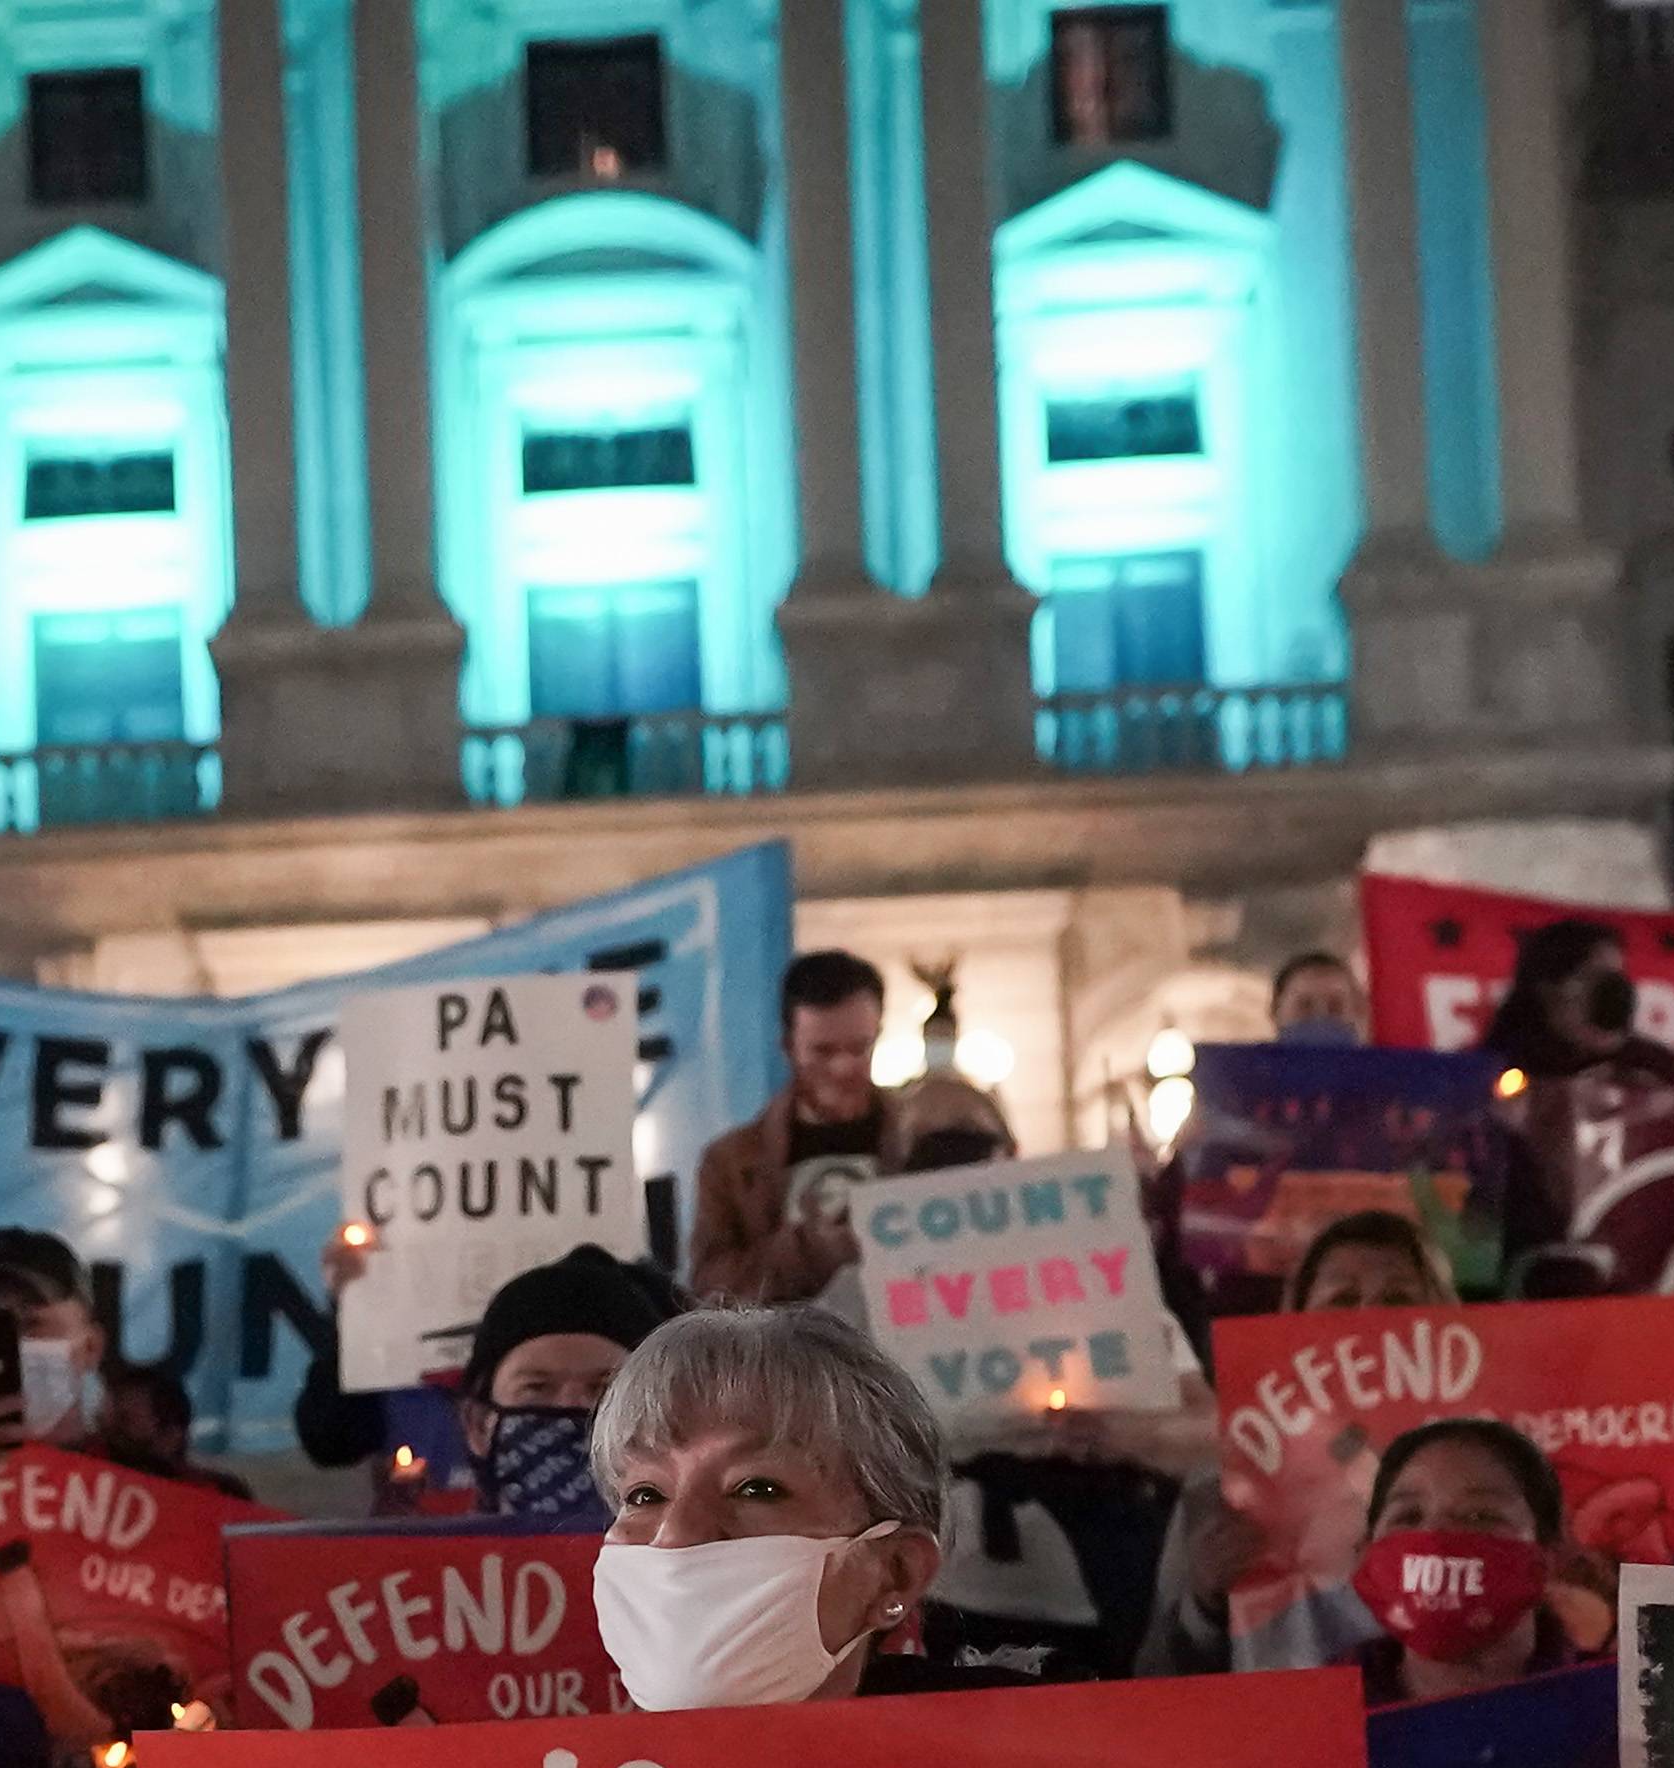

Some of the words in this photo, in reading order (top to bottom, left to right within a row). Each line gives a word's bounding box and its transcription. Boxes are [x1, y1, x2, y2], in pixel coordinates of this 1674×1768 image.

[437, 986, 519, 1051] PA
[381, 1073, 581, 1141] MUST
[365, 1156, 612, 1226] COUNT
[868, 1173, 1113, 1248] COUNT
[885, 1246, 1131, 1328] EVERY
[928, 1330, 1132, 1398] VOTE
[1229, 1319, 1483, 1475] DEFEND
[80, 1552, 156, 1606] OUR
[1401, 1554, 1485, 1597] VOTE
[247, 1552, 567, 1732] DEFEND
[487, 1668, 590, 1720] OUR
